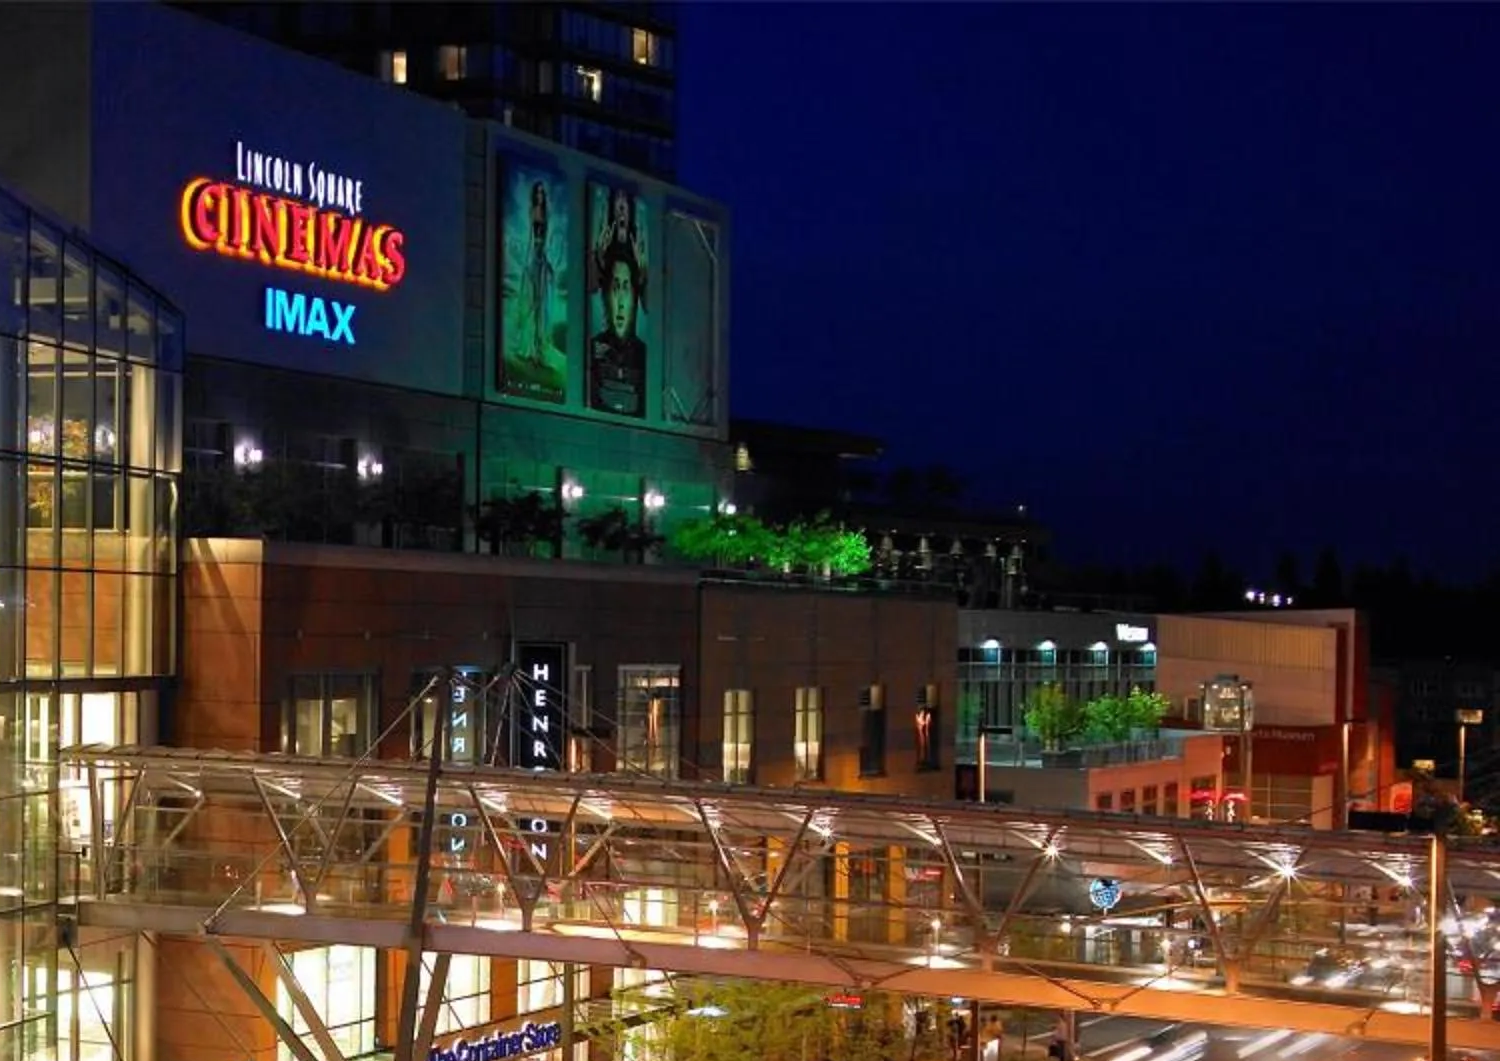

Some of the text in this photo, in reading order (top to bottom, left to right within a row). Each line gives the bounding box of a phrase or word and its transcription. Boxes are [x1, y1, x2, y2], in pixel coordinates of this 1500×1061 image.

[181, 177, 405, 291] CINEMAS
[265, 287, 356, 344] IMAX
[521, 1020, 562, 1051] Store
